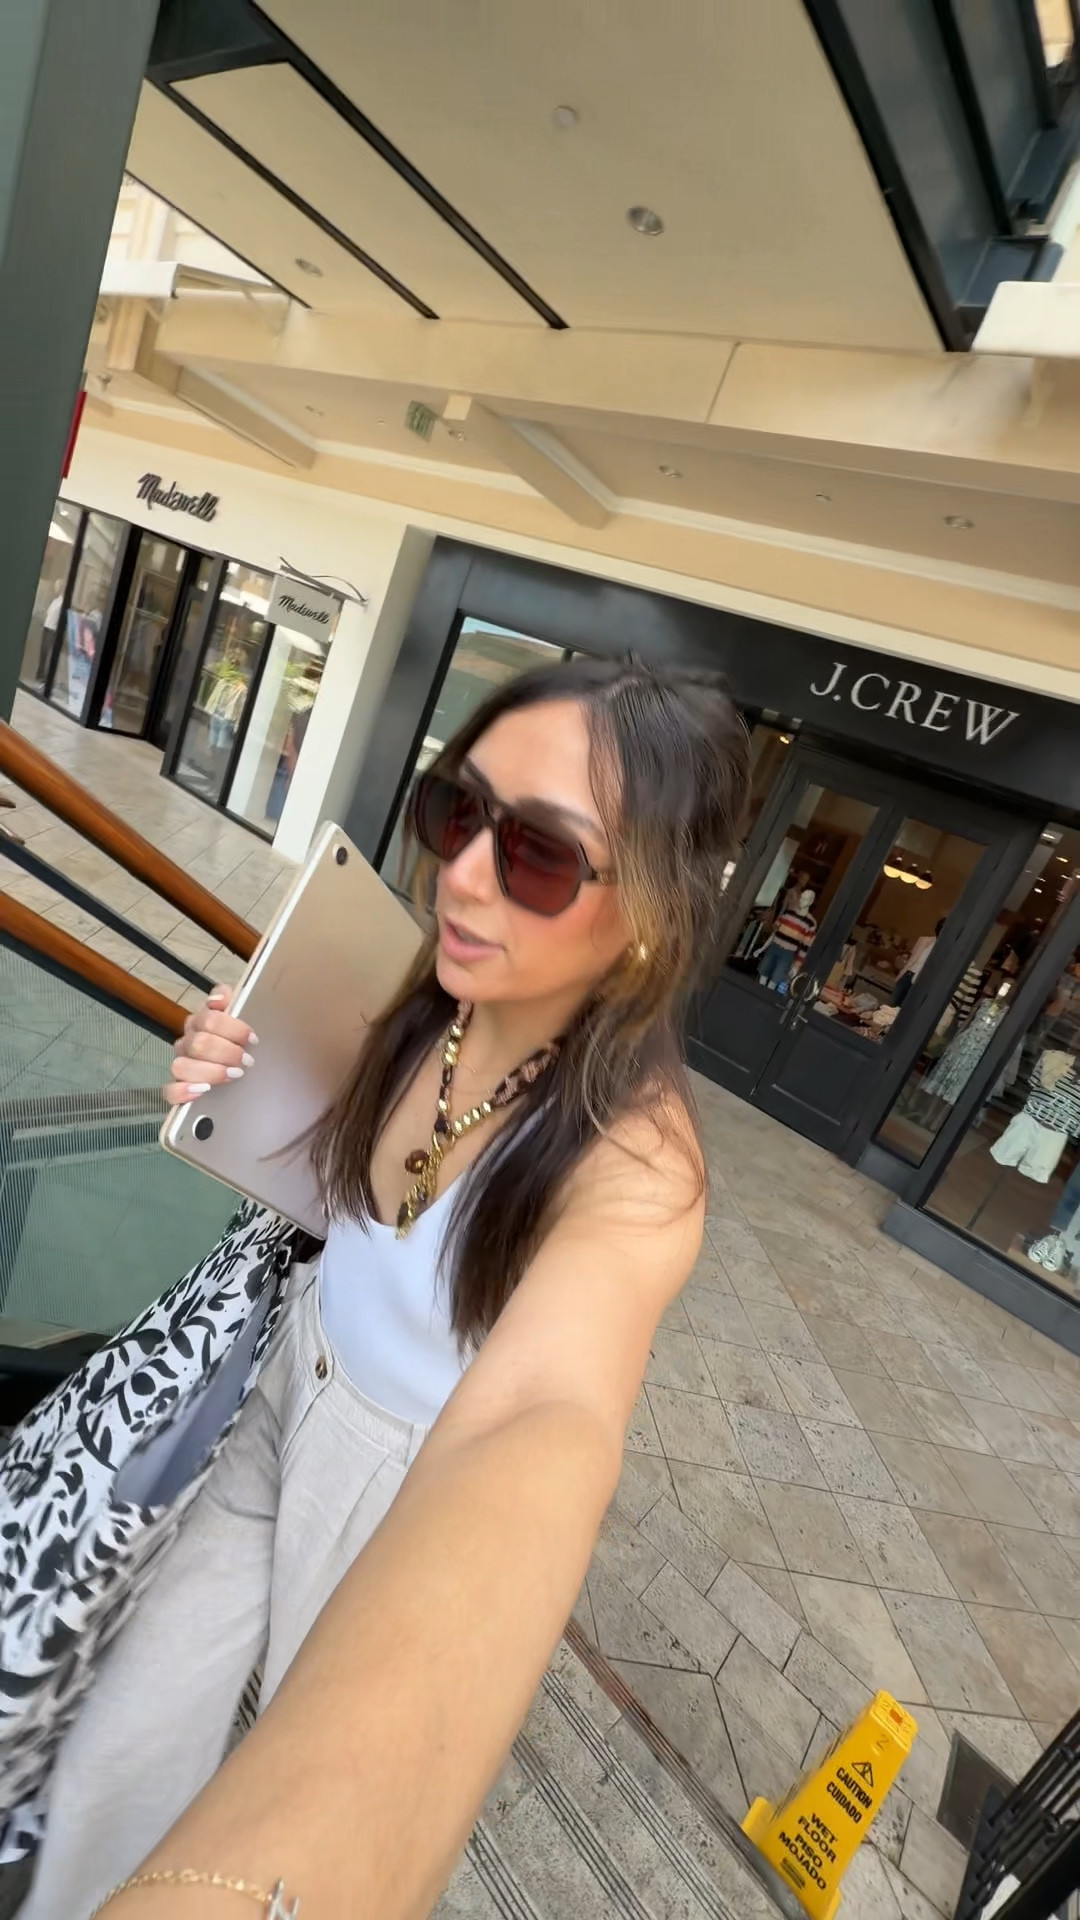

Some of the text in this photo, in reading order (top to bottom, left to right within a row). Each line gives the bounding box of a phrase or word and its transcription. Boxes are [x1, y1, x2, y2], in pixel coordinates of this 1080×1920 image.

[136, 472, 220, 522] Madewell
[277, 595, 330, 624] Madewell
[810, 662, 1020, 745] J.CREW
[826, 1781, 863, 1824] CUIDADO
[836, 1767, 873, 1809] CAUTION
[798, 1815, 837, 1864] FLOOR
[811, 1812, 838, 1844] WET
[779, 1831, 827, 1890] MOJADO
[795, 1833, 823, 1868] PISO
